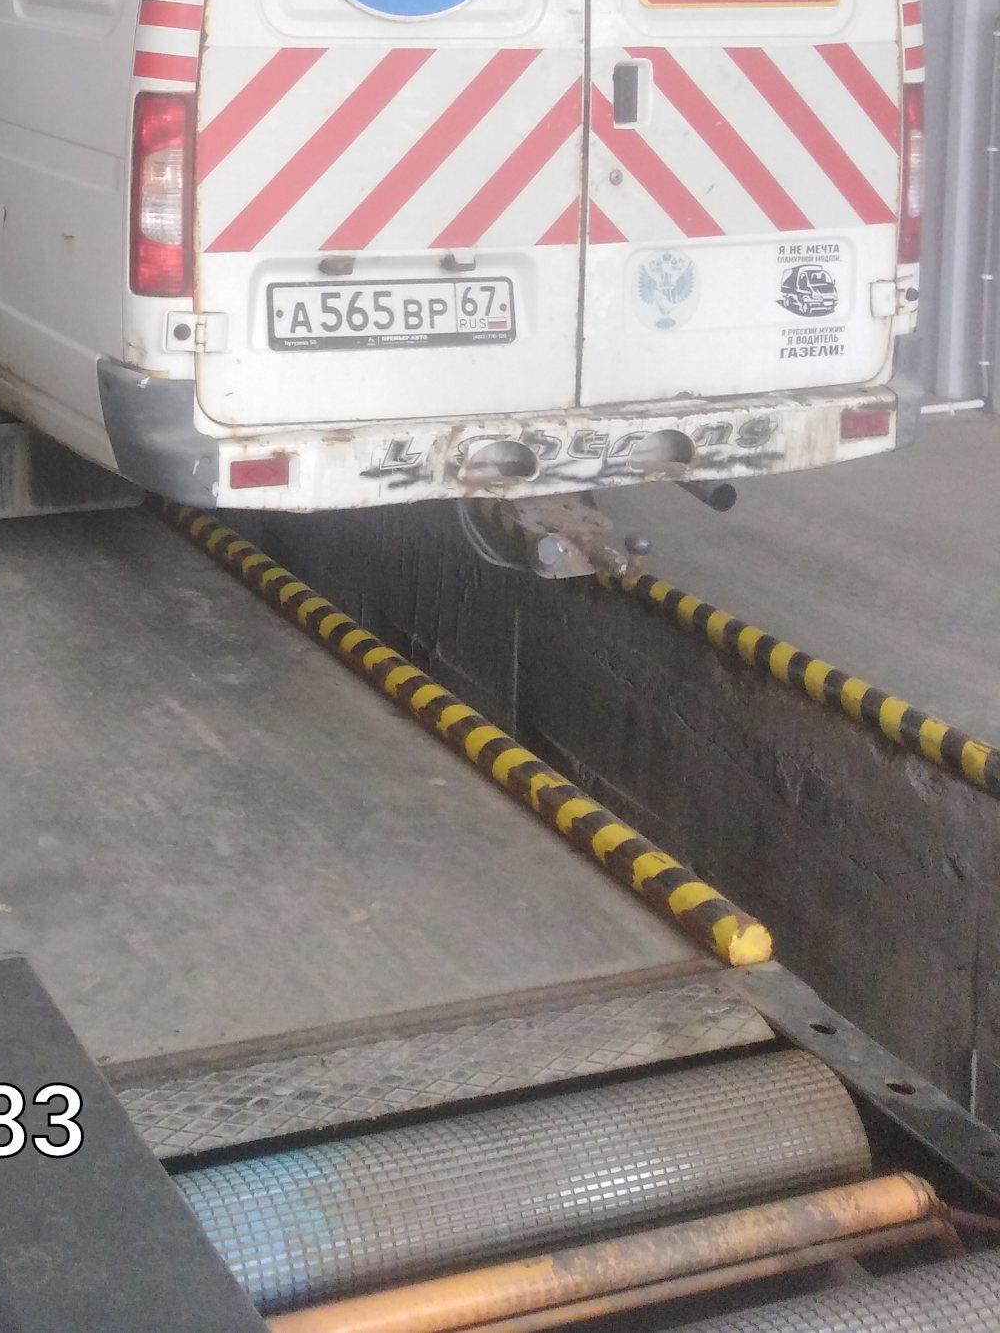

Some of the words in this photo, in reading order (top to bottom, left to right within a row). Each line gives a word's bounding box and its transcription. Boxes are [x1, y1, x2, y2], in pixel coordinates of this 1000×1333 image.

[779, 246, 786, 255] Я
[789, 245, 802, 255] НЕ
[806, 244, 840, 254] МЕЧТА
[290, 290, 448, 334] А565ВР
[461, 286, 496, 316] 67
[459, 318, 487, 329] RUS
[788, 337, 793, 346] Я
[796, 334, 839, 345] ВОДИТЕЛЬ
[780, 345, 845, 359] ГАЗЕЛИ!
